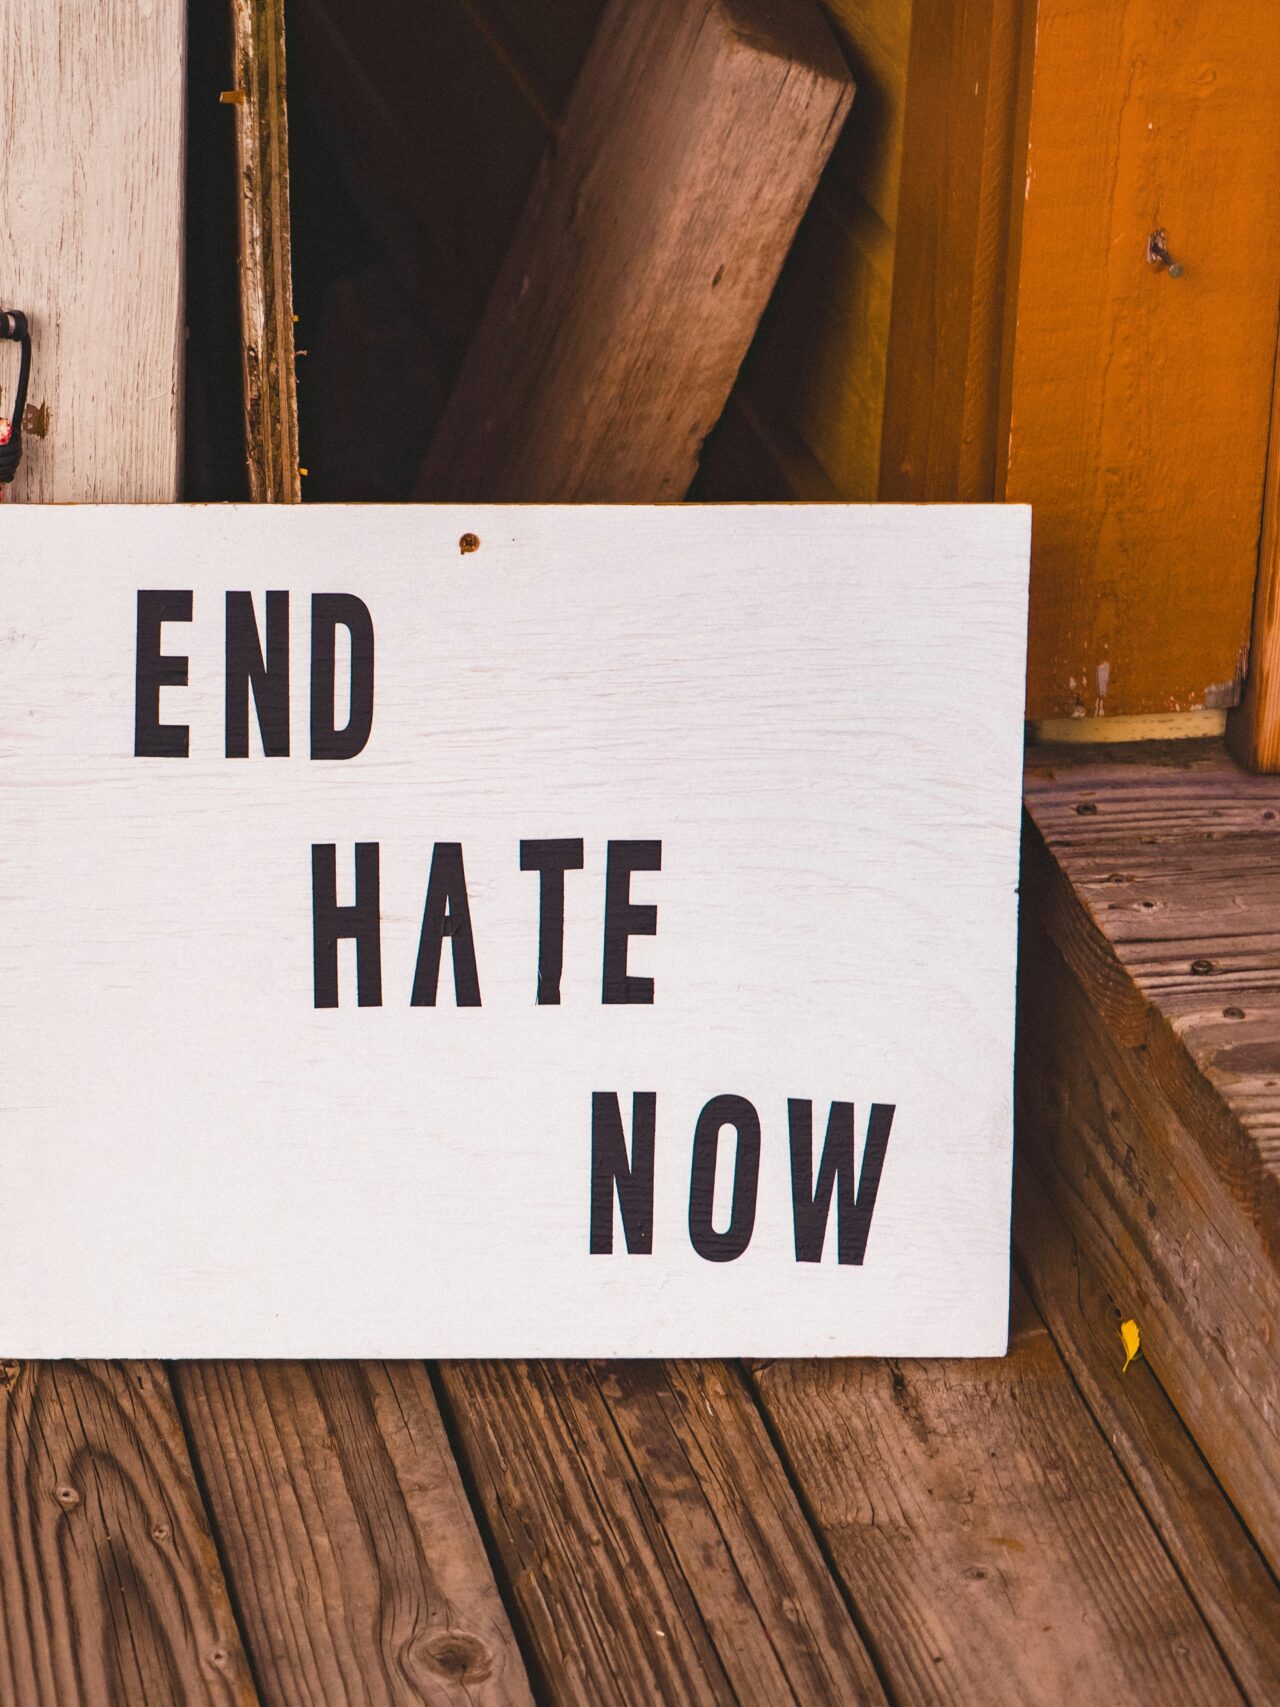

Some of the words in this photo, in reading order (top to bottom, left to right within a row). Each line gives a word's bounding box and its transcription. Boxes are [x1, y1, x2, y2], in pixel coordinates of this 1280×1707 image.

[134, 590, 375, 760] END
[312, 838, 662, 1008] HATE
[589, 1092, 896, 1266] NOW
